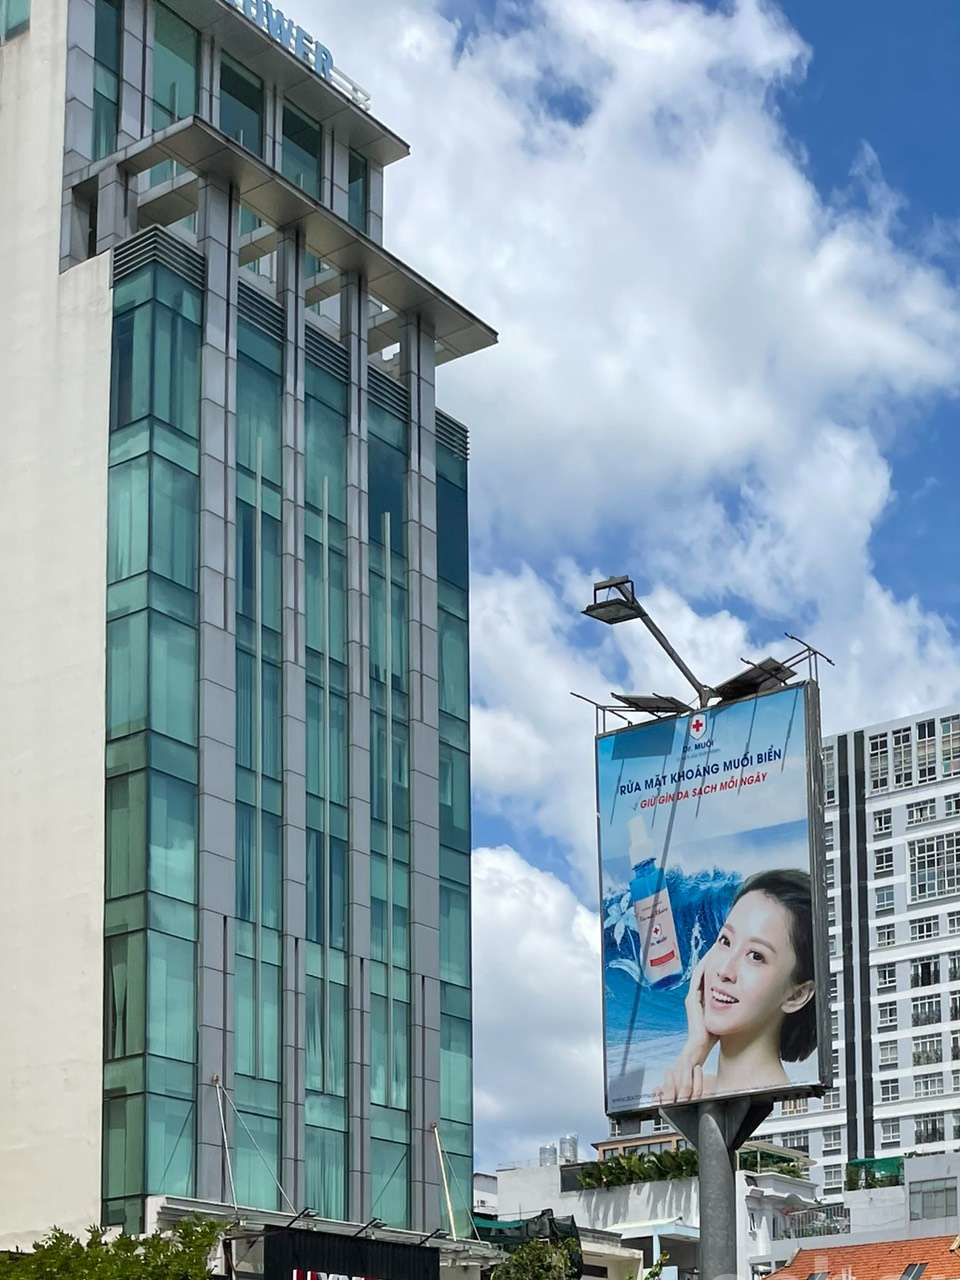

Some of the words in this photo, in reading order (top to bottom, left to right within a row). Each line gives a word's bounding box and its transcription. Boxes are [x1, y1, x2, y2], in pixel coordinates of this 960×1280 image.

[224, 0, 334, 81] OWER
[620, 779, 641, 795] RỬA
[644, 774, 667, 792] MẶT
[670, 763, 720, 785] KHOÁNG
[723, 751, 754, 773] MUỐI
[756, 744, 782, 765] BIỂN
[676, 790, 689, 801] DA
